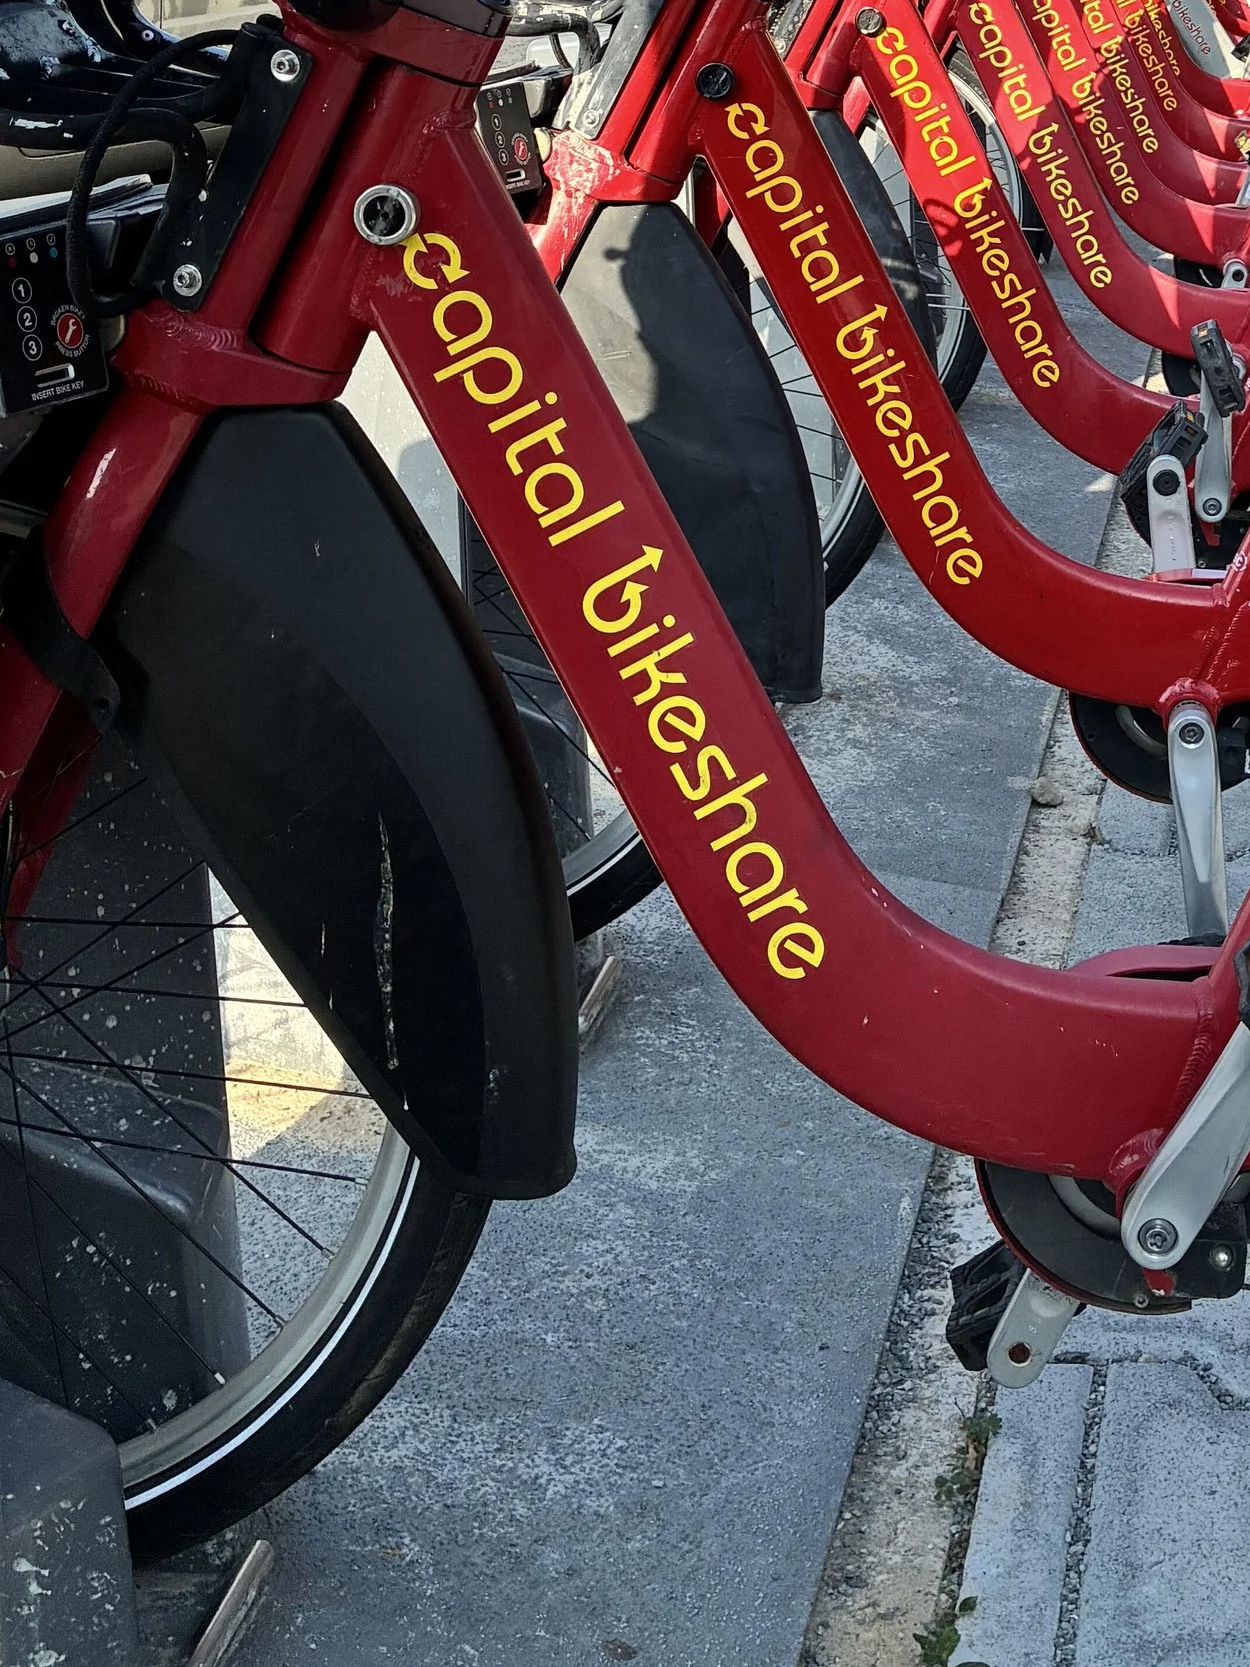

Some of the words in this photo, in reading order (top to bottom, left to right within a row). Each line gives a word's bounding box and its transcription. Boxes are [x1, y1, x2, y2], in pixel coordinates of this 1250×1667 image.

[1100, 34, 1159, 154] bikeshare
[1124, 8, 1178, 112] bikeshare
[968, 2, 1046, 122] capital
[1028, 122, 1113, 289] bikeshare
[1072, 70, 1140, 205] bikeshare
[876, 26, 977, 177] capital
[953, 176, 1060, 389] bikeshare
[17, 283, 26, 298] 1
[22, 312, 33, 327] 2
[28, 340, 37, 355] 3
[724, 102, 865, 304] capital
[836, 303, 984, 586] bikeshare
[31, 388, 55, 401] INSERT
[55, 383, 71, 395] BIKE
[71, 380, 84, 390] KEY
[402, 231, 626, 548] capital
[582, 543, 825, 981] bikeshare
